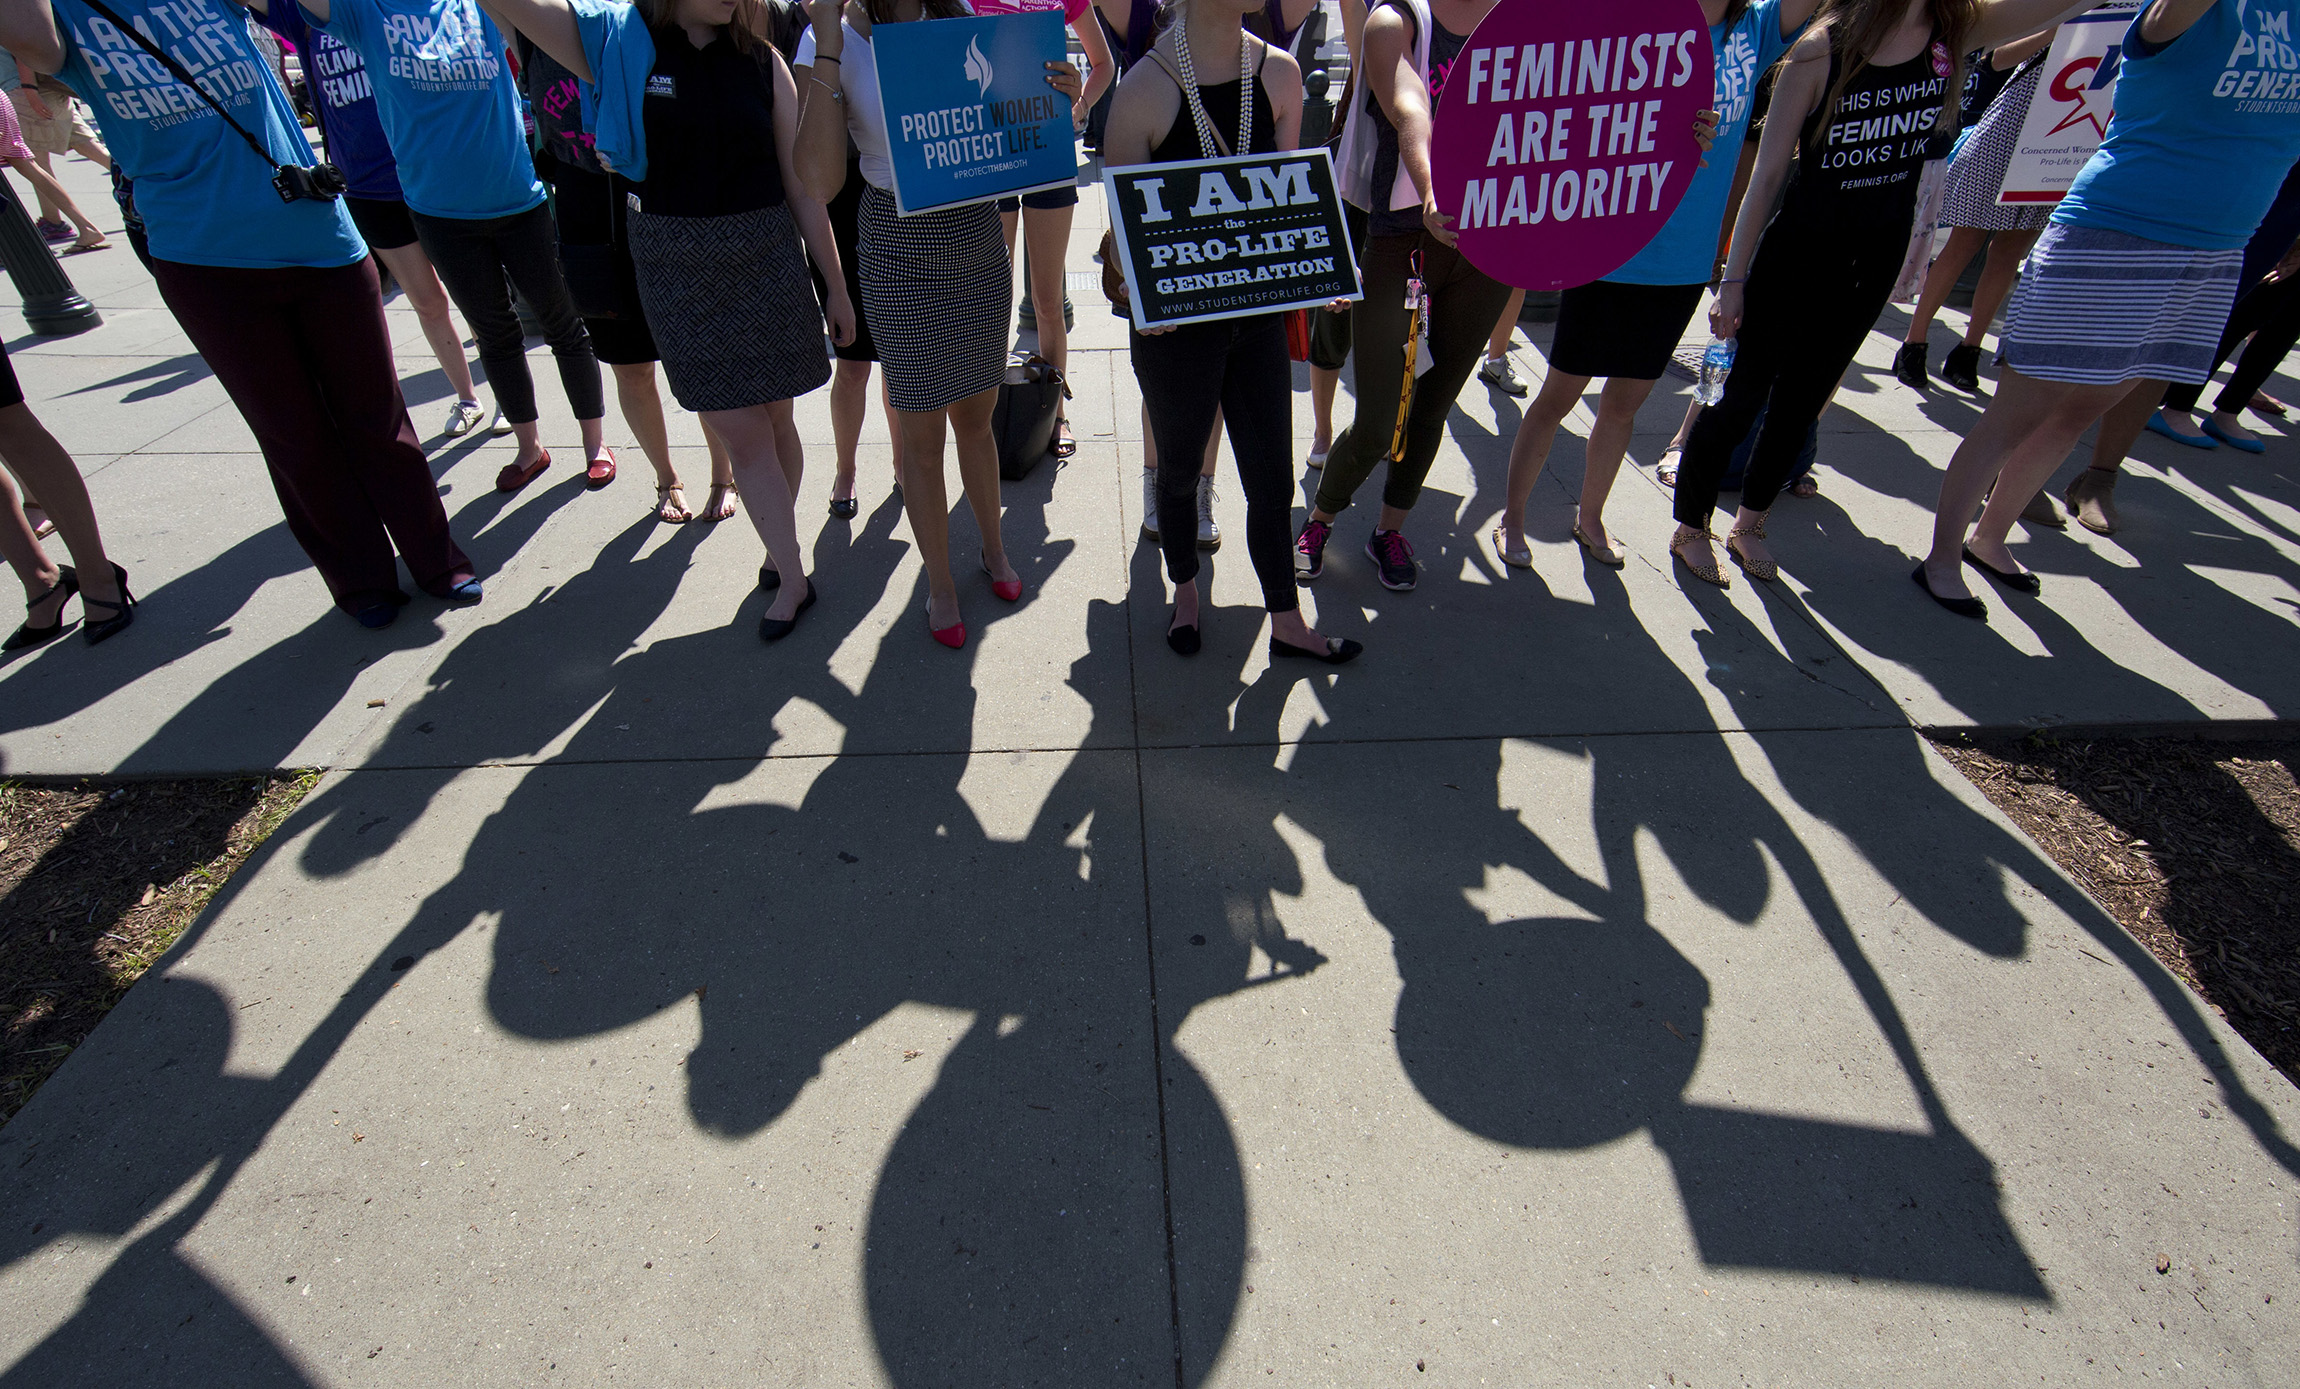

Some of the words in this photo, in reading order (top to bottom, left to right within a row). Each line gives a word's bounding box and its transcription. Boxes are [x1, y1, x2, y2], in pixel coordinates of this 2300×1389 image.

[1467, 29, 1697, 105] FEMINISTS
[2225, 29, 2300, 70] PRO
[389, 57, 500, 81] GENERATION
[410, 80, 491, 92] STUDENTSFORLIFE.ORG
[105, 59, 263, 120] GENERATION
[1834, 92, 1871, 115] THIS
[1875, 89, 1891, 108] IS
[1895, 77, 1945, 104] WHAT
[901, 104, 983, 142] PROTECT
[989, 94, 1059, 128] WOMEN.
[1486, 107, 1573, 167] ARE
[1588, 99, 1662, 158] THE
[923, 131, 1003, 170] PROTECT
[1008, 125, 1048, 154] LIFE.
[1821, 144, 1892, 169] LOOKS
[2020, 146, 2070, 155] Concerned
[2039, 156, 2072, 167] Pro-Life
[2072, 157, 2081, 165] is
[954, 159, 1028, 180] #PROTECTTHEMBOTH
[1840, 170, 1909, 190] FEMINIST.ORG
[1133, 178, 1172, 223] I
[1189, 162, 1319, 217] AM
[1458, 160, 1674, 230] MAJORITY
[1223, 219, 1246, 229] the
[1147, 226, 1331, 269] PRO-LIFE
[1155, 256, 1335, 295] GENERATION
[1160, 281, 1341, 315] WWW.STUDENTSFORLIFE.ORG
